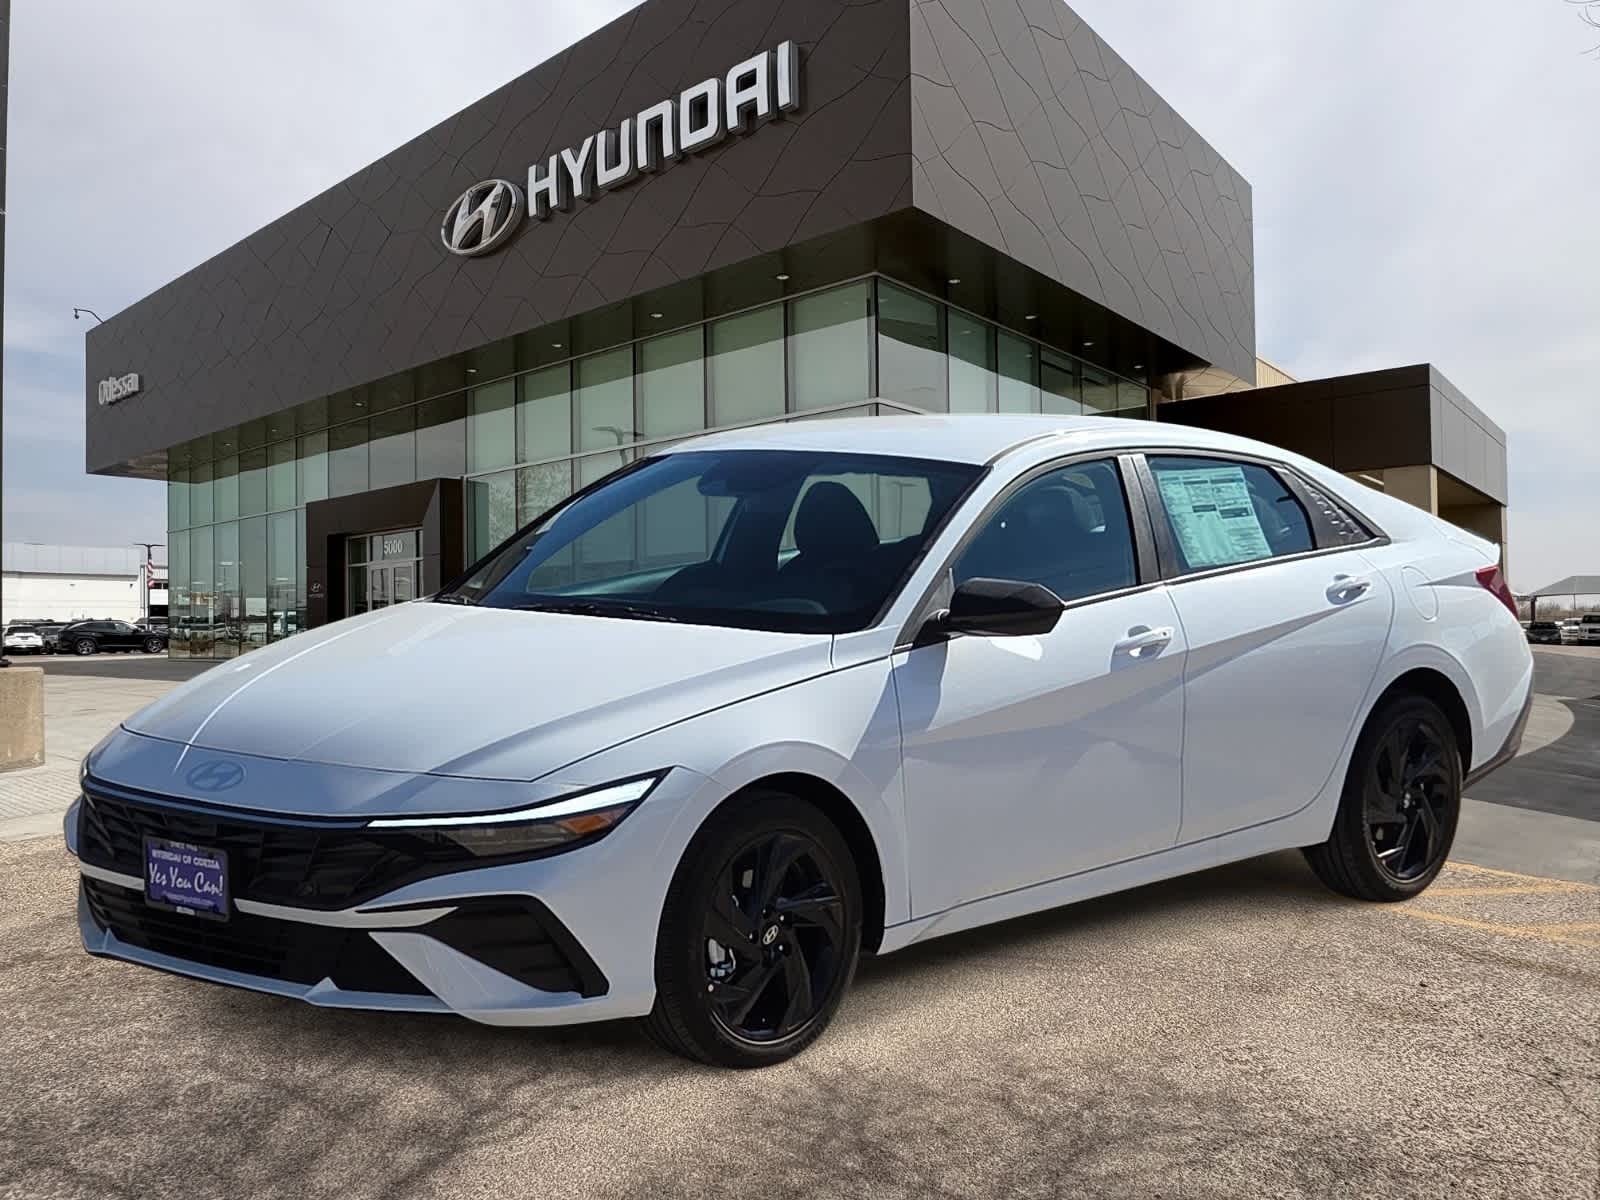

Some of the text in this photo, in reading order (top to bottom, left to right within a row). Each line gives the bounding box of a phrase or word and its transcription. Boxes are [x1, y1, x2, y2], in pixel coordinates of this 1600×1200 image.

[527, 40, 797, 219] HYUNDAI
[384, 539, 403, 555] 5000
[149, 862, 224, 897] Yes You Can!
